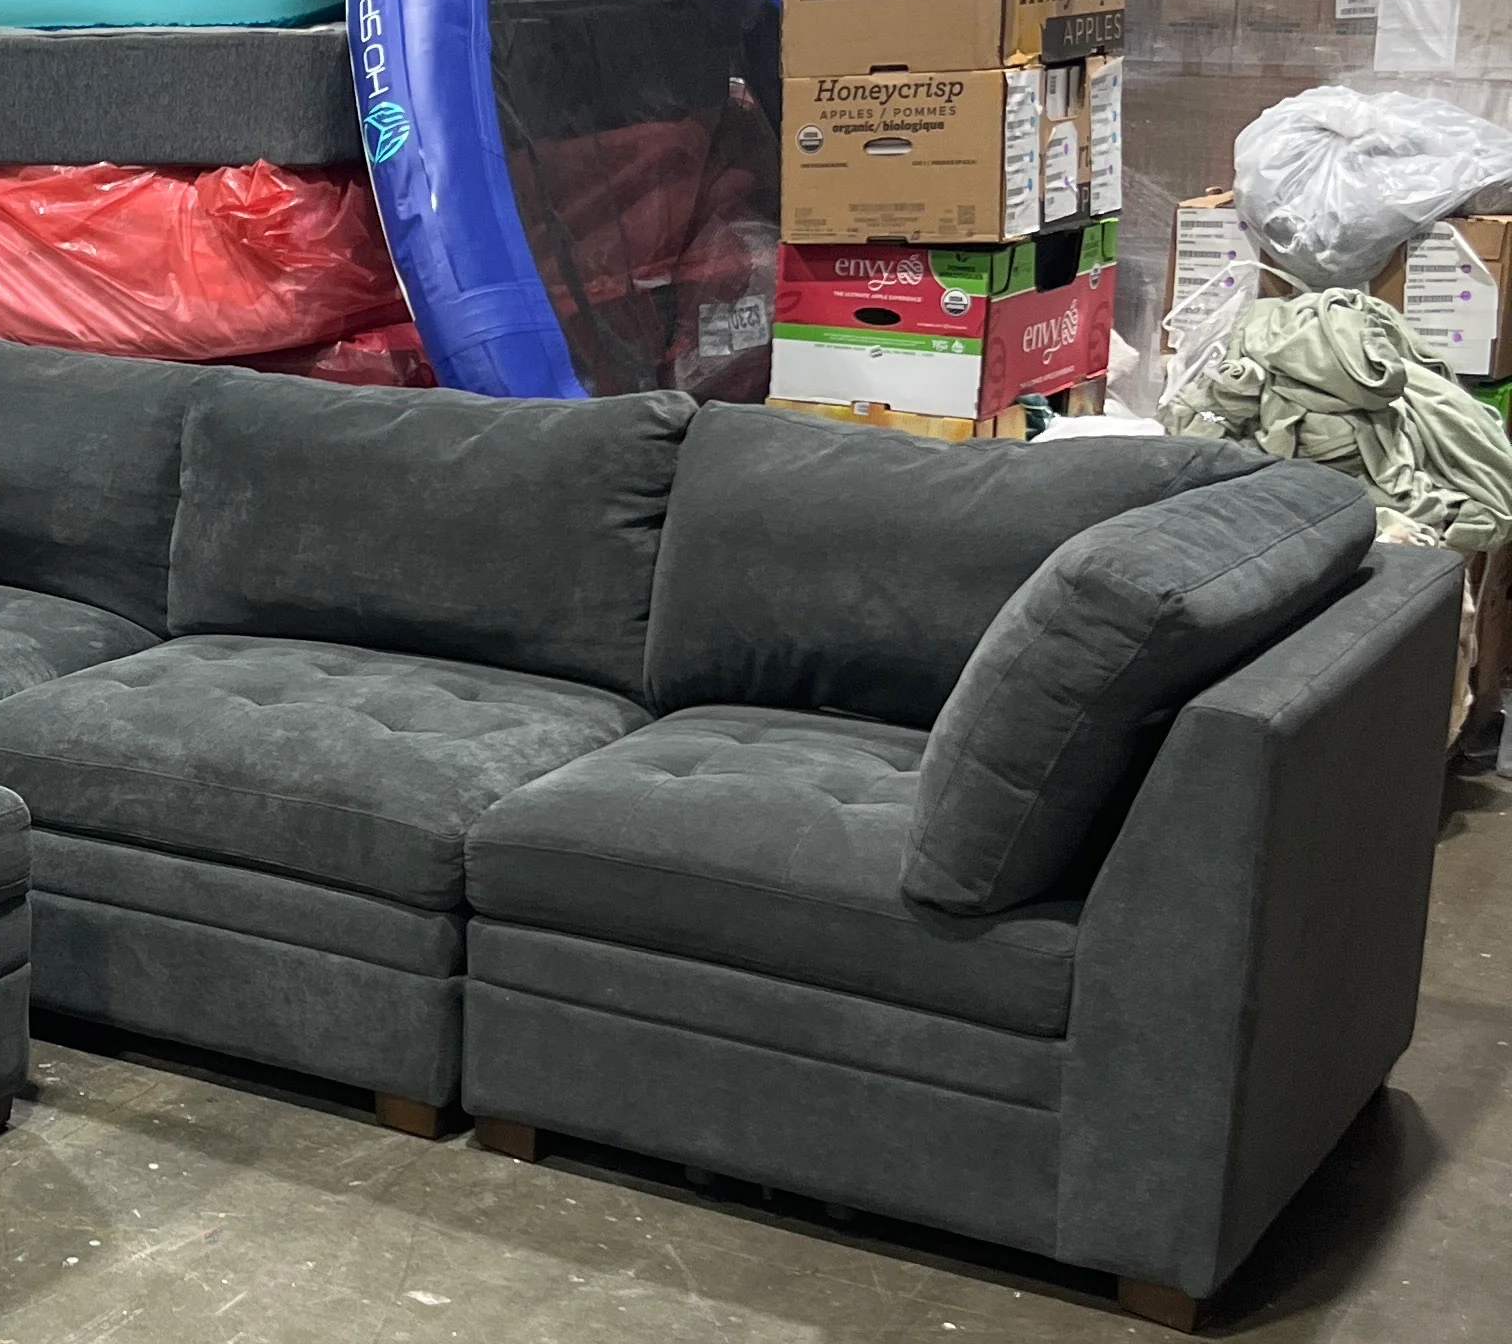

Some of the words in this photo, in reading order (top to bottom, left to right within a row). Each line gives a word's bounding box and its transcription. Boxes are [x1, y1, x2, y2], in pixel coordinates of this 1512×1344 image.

[1063, 13, 1121, 46] APPLES
[363, 43, 388, 99] HO
[814, 77, 964, 105] Honeycrisp
[820, 108, 873, 120] APPLES
[893, 106, 957, 118] POMMES
[834, 258, 897, 292] envy
[1022, 316, 1063, 365] envy
